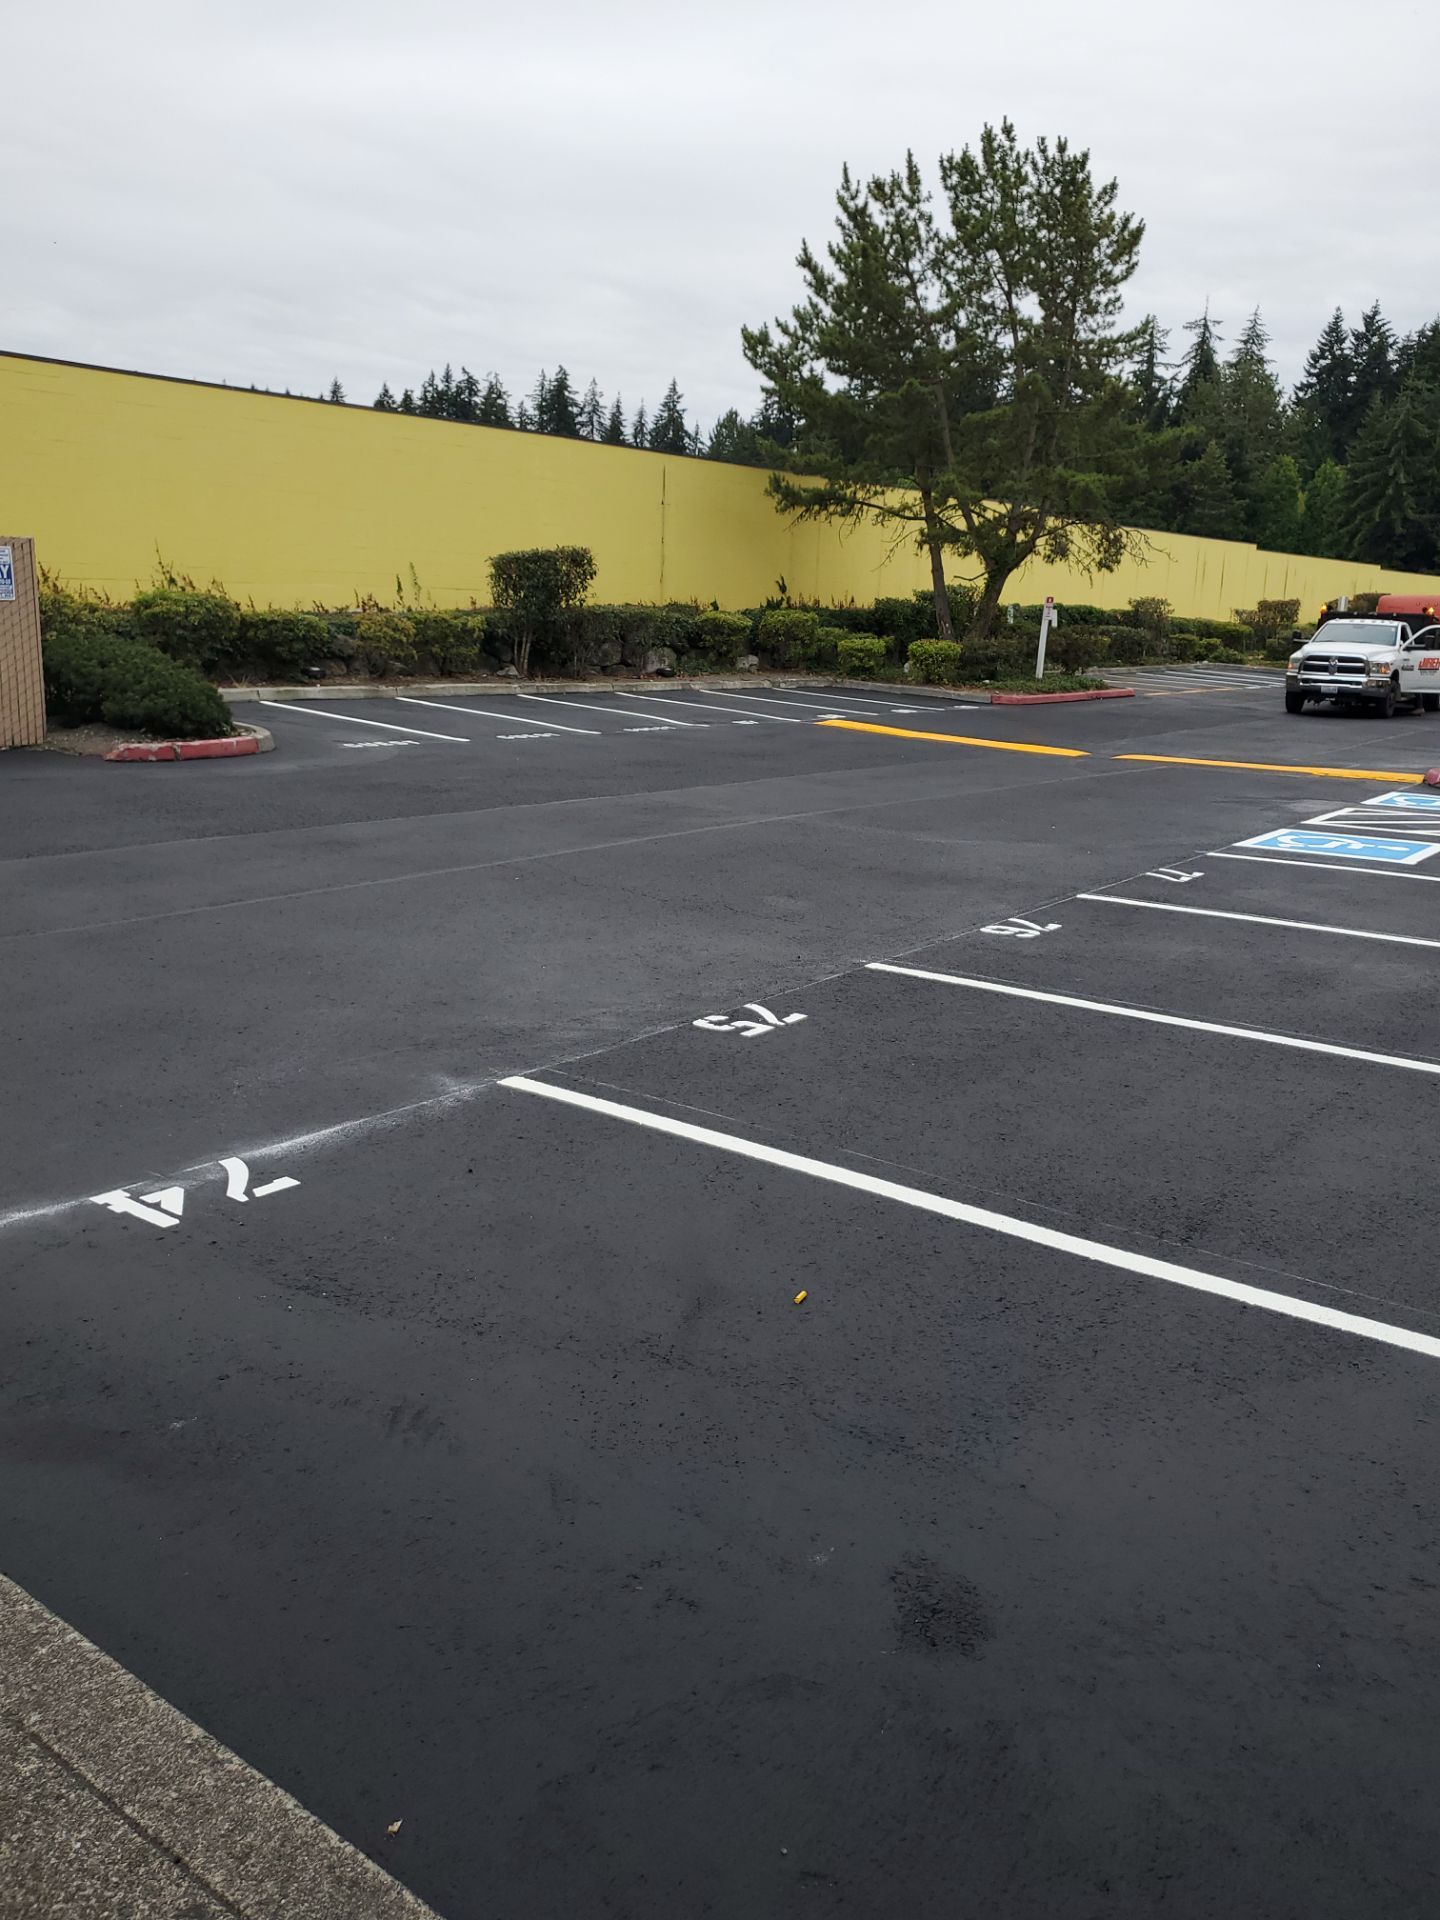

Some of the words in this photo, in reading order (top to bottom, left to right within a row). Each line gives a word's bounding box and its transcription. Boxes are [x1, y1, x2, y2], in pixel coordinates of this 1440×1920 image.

[1145, 868, 1205, 882] 77
[980, 917, 1062, 938] 76
[692, 1003, 808, 1037] 75
[89, 1156, 301, 1228] 74
